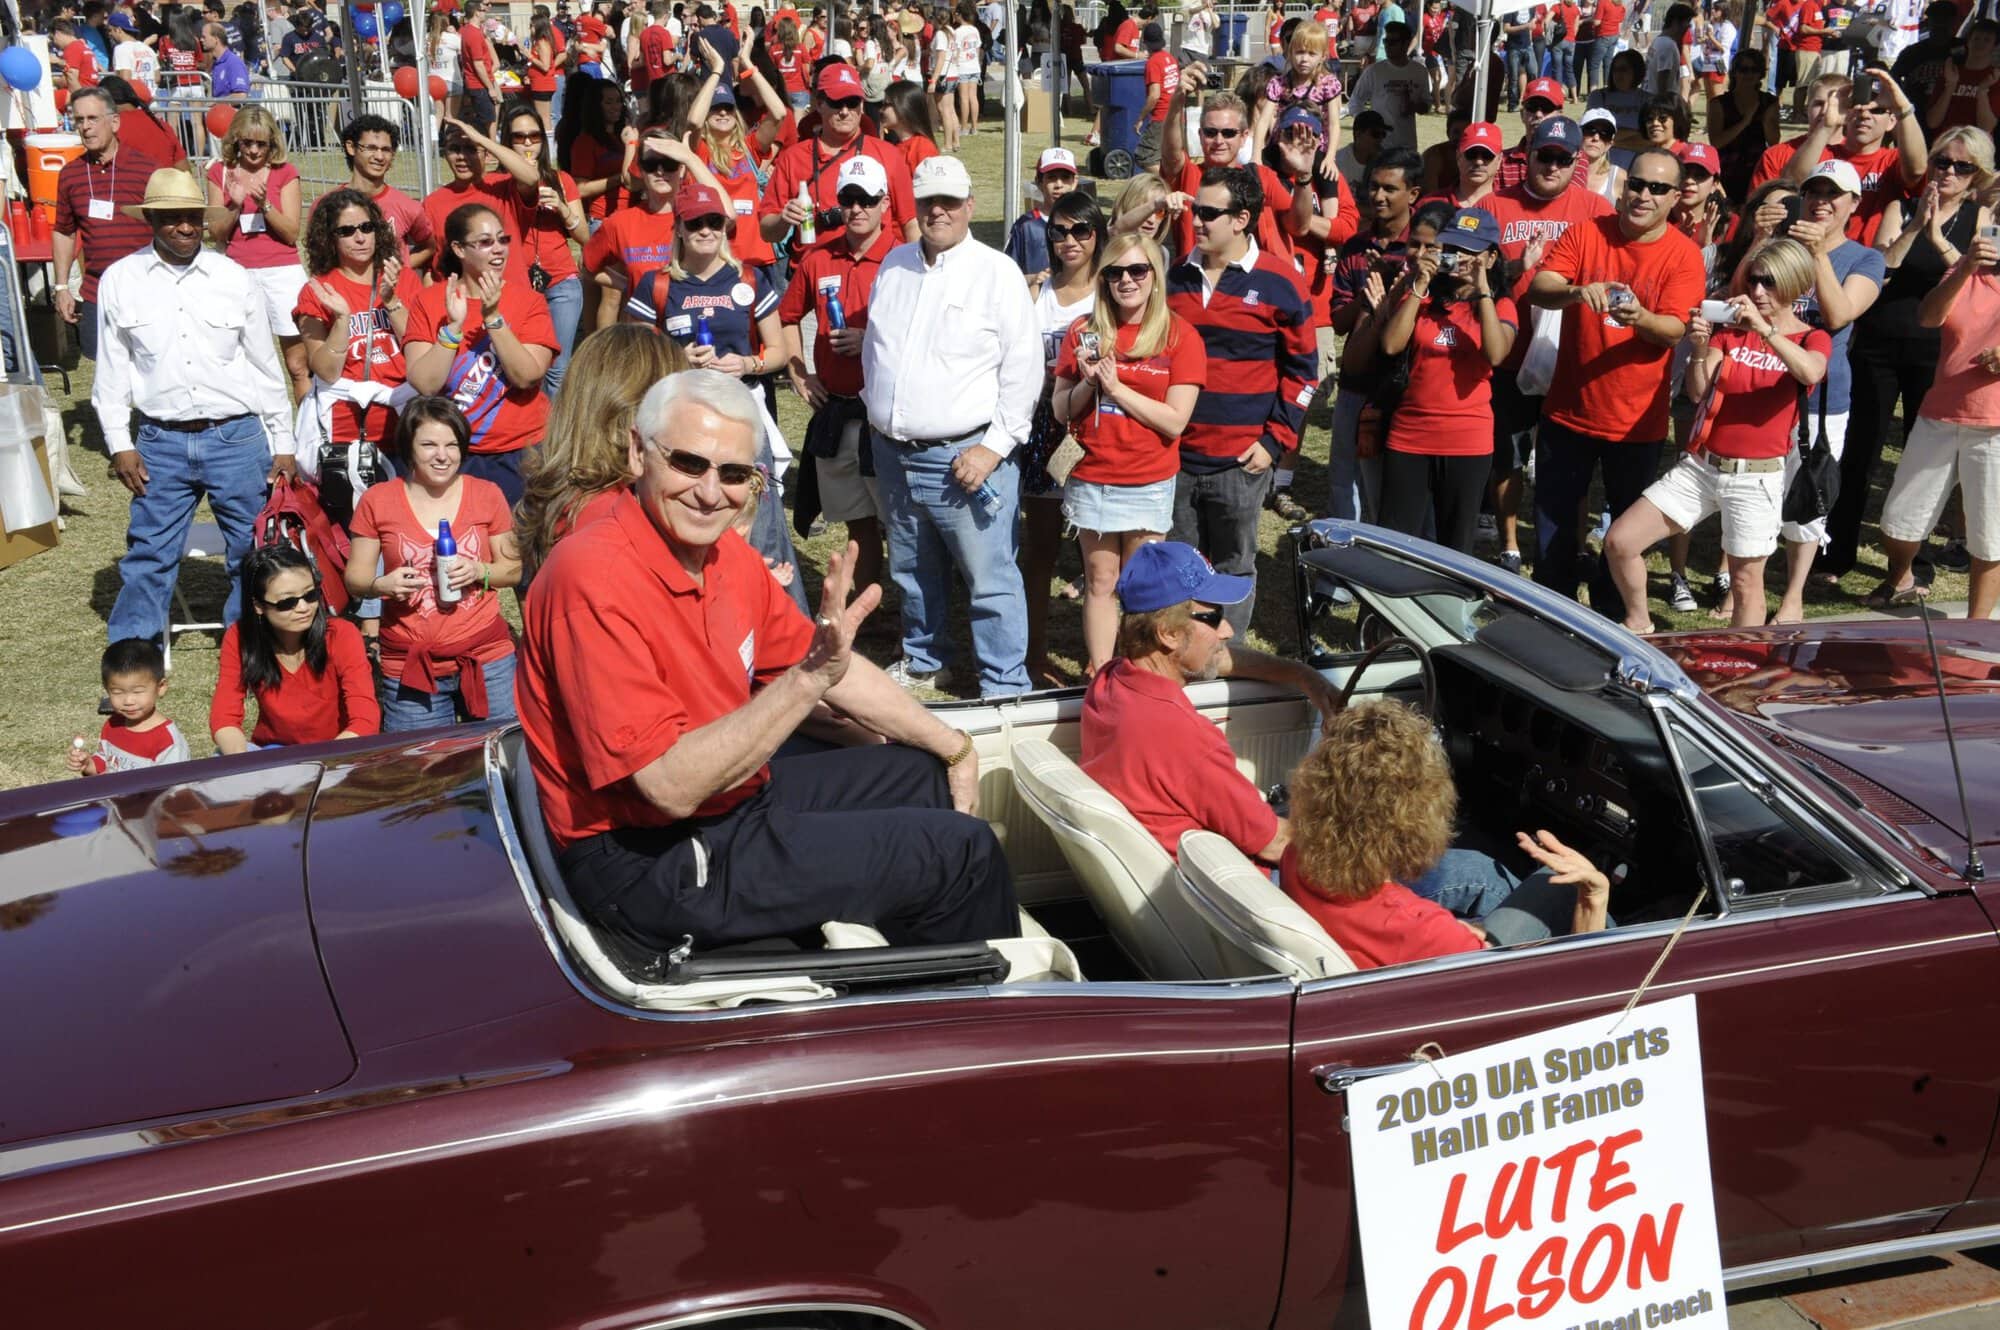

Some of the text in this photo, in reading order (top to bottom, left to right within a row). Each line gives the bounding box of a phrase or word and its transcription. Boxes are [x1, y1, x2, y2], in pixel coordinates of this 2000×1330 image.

[1502, 219, 1572, 243] ARIZON
[681, 295, 736, 311] ARIZONA
[1376, 1026, 1671, 1132] 2009 UA Sports
[1410, 1077, 1645, 1167] Hall of Fame
[1435, 1128, 1643, 1255] LUTE
[1407, 1202, 1685, 1330] OLSON
[1644, 1287, 1714, 1329] Coach
